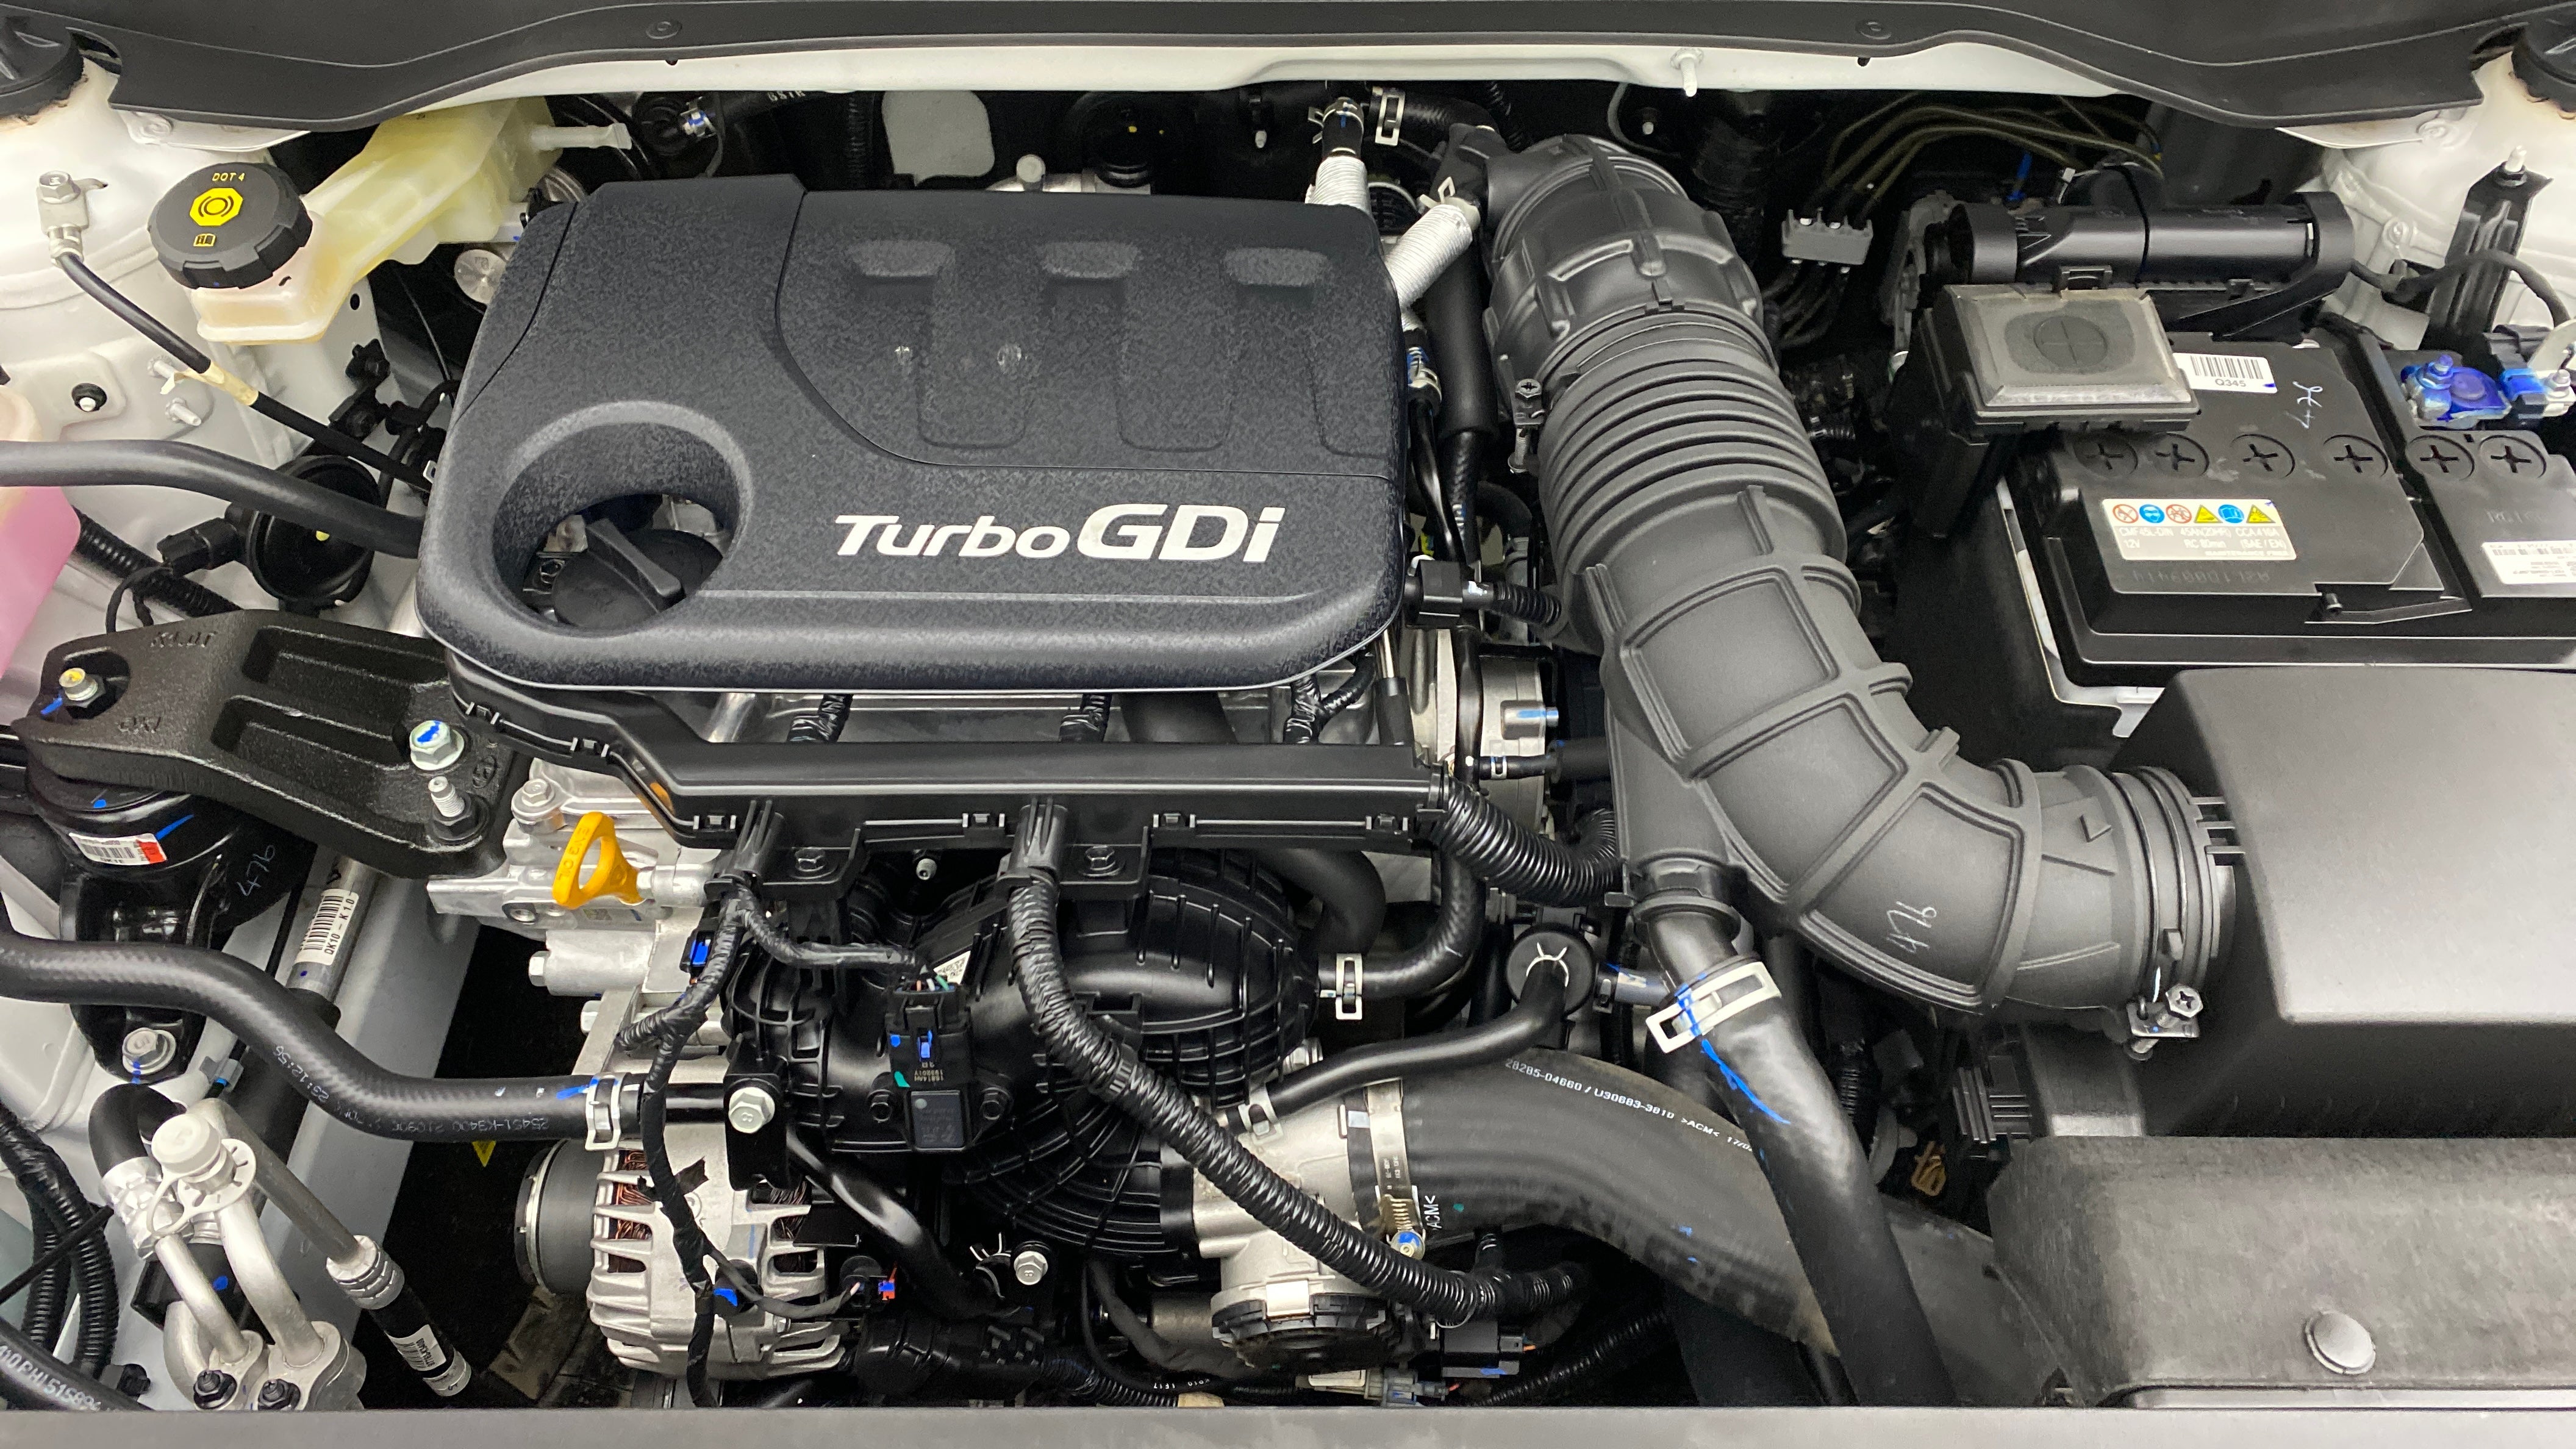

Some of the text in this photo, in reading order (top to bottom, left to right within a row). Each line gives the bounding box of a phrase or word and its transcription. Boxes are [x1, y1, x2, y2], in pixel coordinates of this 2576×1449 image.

[212, 173, 245, 182] DOT 4
[2214, 378, 2247, 387] Q345
[2123, 538, 2141, 548] 12V
[236, 845, 275, 896] 476
[1681, 1117, 1720, 1137] >ACM<
